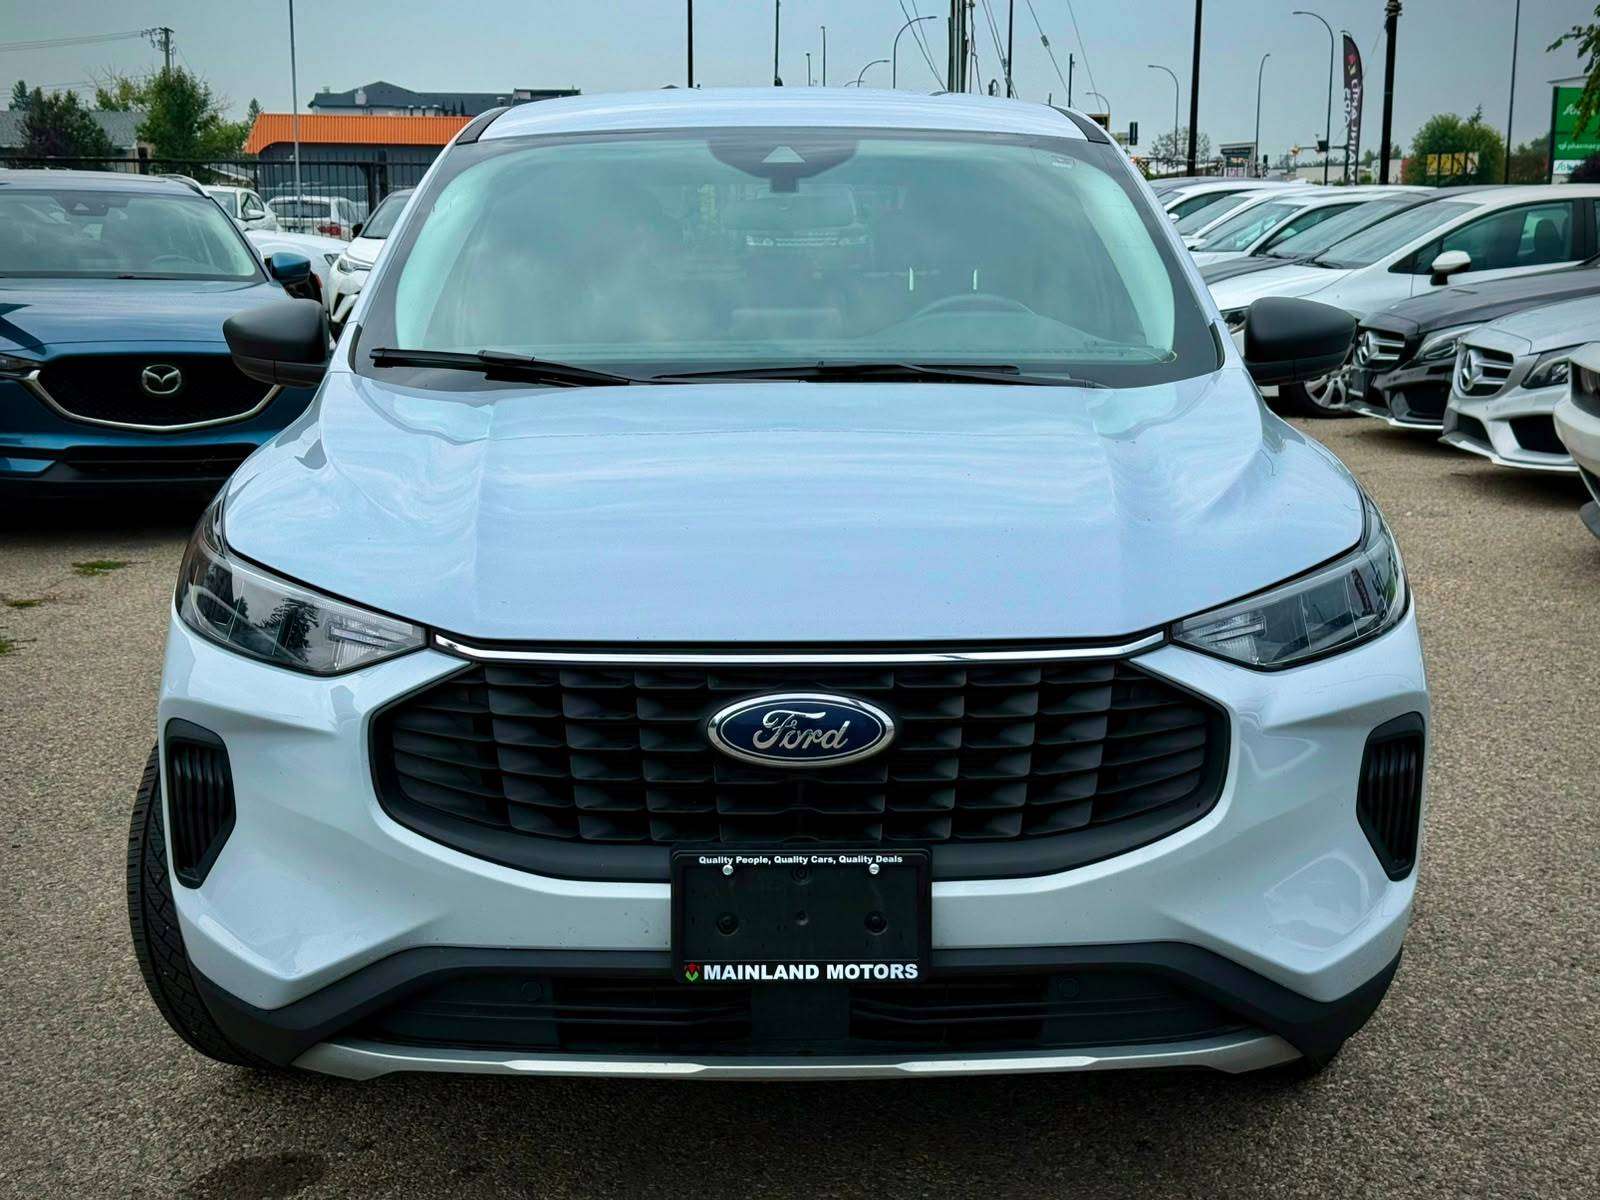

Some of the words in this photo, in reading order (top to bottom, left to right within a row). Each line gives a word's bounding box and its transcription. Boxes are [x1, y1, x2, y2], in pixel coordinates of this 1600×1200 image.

[752, 710, 850, 750] Ford
[699, 856, 733, 864] Quality
[736, 856, 771, 864] People,
[774, 856, 808, 864] Quality
[811, 855, 837, 864] Cars,
[839, 855, 873, 863] Quality
[876, 855, 902, 863] Deals
[703, 964, 820, 981] MAINLAND
[826, 964, 919, 980] MOTORS
